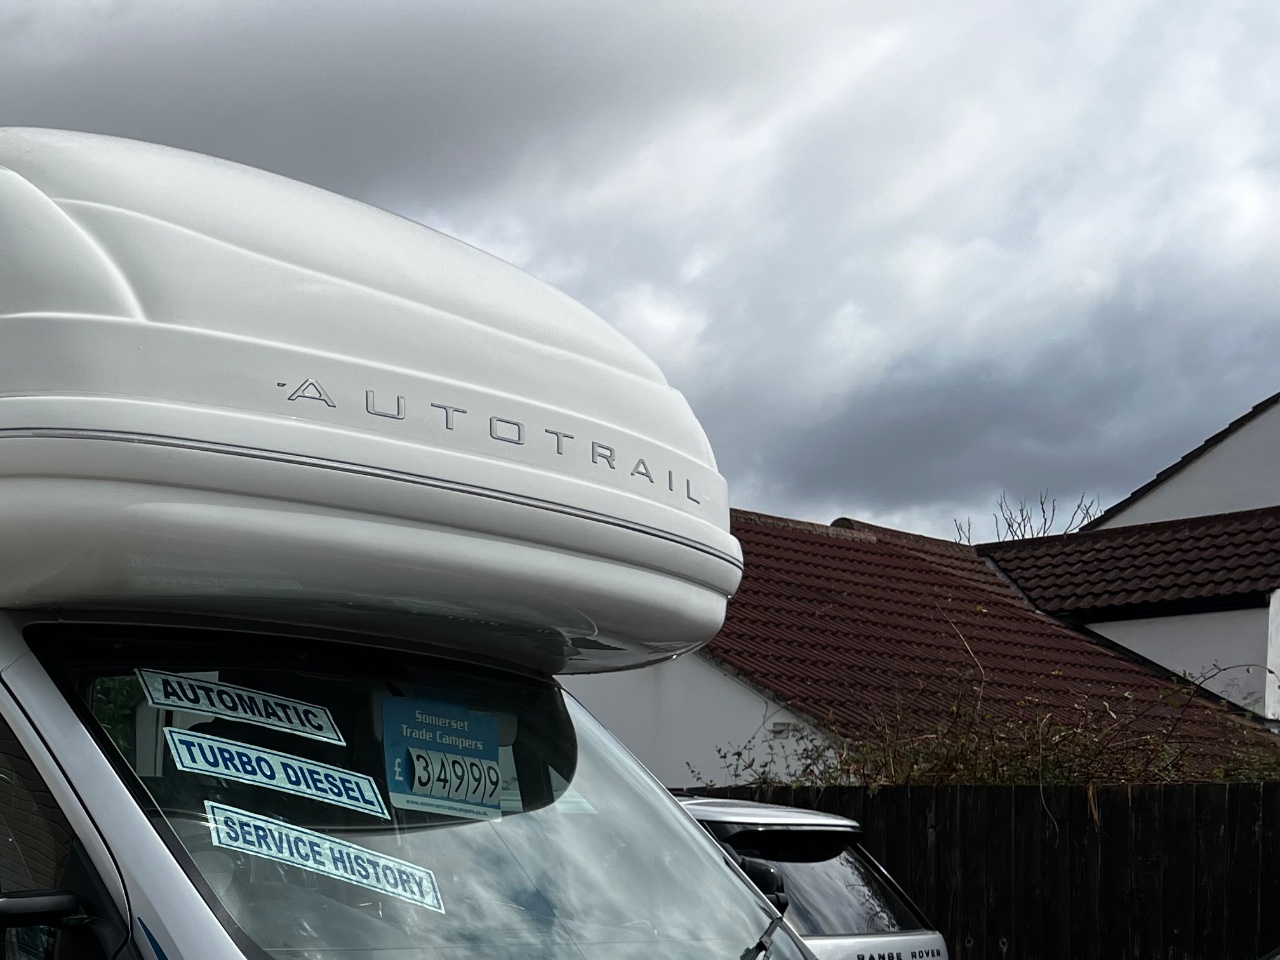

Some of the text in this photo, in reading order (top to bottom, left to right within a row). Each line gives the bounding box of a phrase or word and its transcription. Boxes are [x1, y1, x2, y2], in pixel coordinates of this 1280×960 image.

[286, 378, 701, 505] AUTOTRAIL
[161, 678, 325, 732] AUTOMATIC
[415, 710, 470, 732] Somerset
[401, 724, 484, 751] Trade Campers
[178, 739, 377, 807] TURBO DIESEL
[393, 754, 500, 799] £ 34999
[222, 815, 428, 901] SERVICE HISTORY
[910, 949, 942, 960] ROVER
